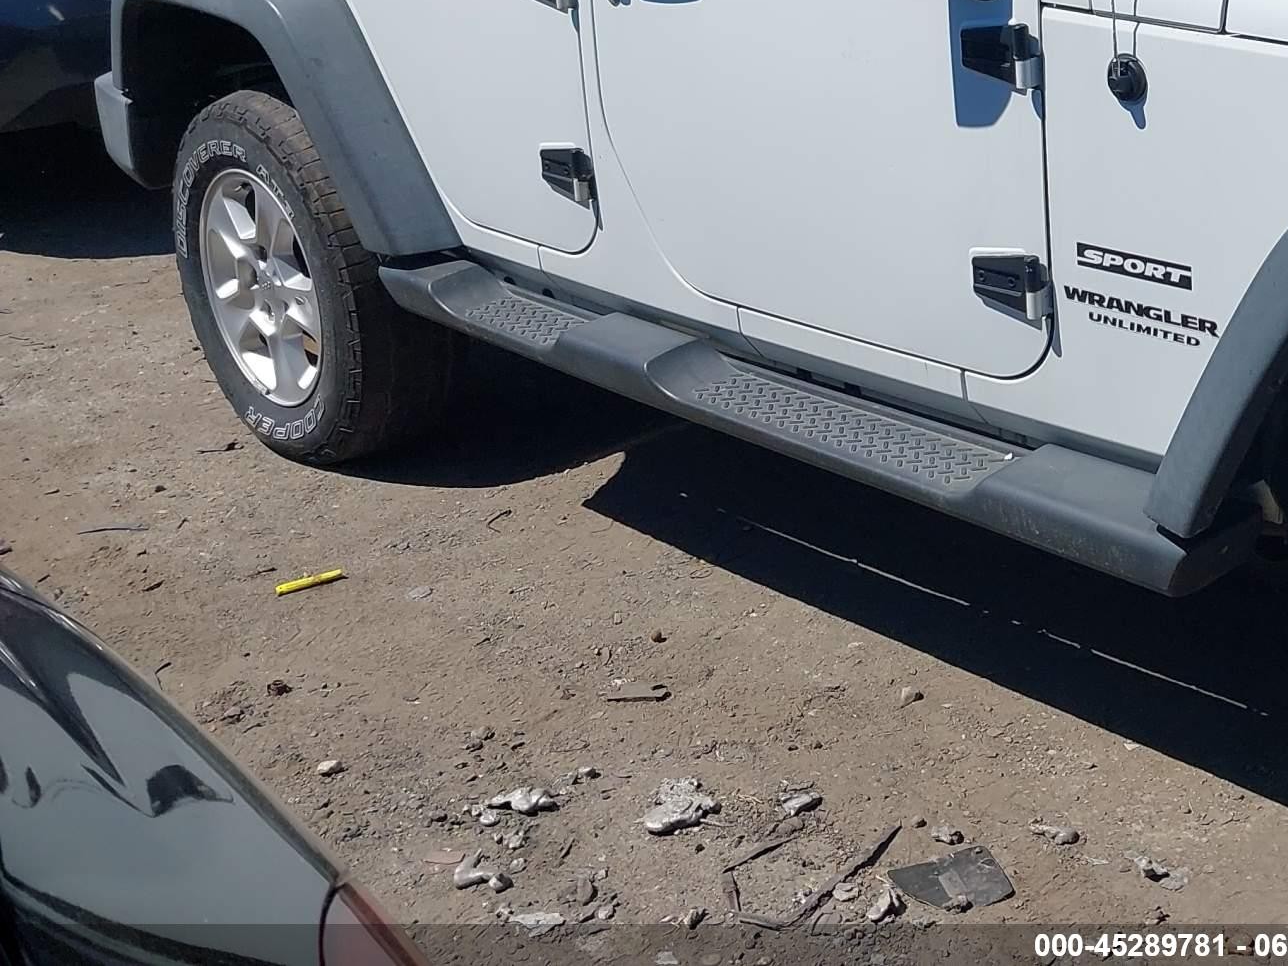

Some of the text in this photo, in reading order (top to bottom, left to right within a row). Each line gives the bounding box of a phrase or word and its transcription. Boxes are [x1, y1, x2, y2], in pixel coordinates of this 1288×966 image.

[176, 140, 247, 259] DISCOVERER
[1080, 249, 1192, 283] SPORT
[1064, 285, 1219, 338] WRANGLER
[1088, 311, 1201, 346] UNLIMITED
[245, 394, 326, 440] COOPER
